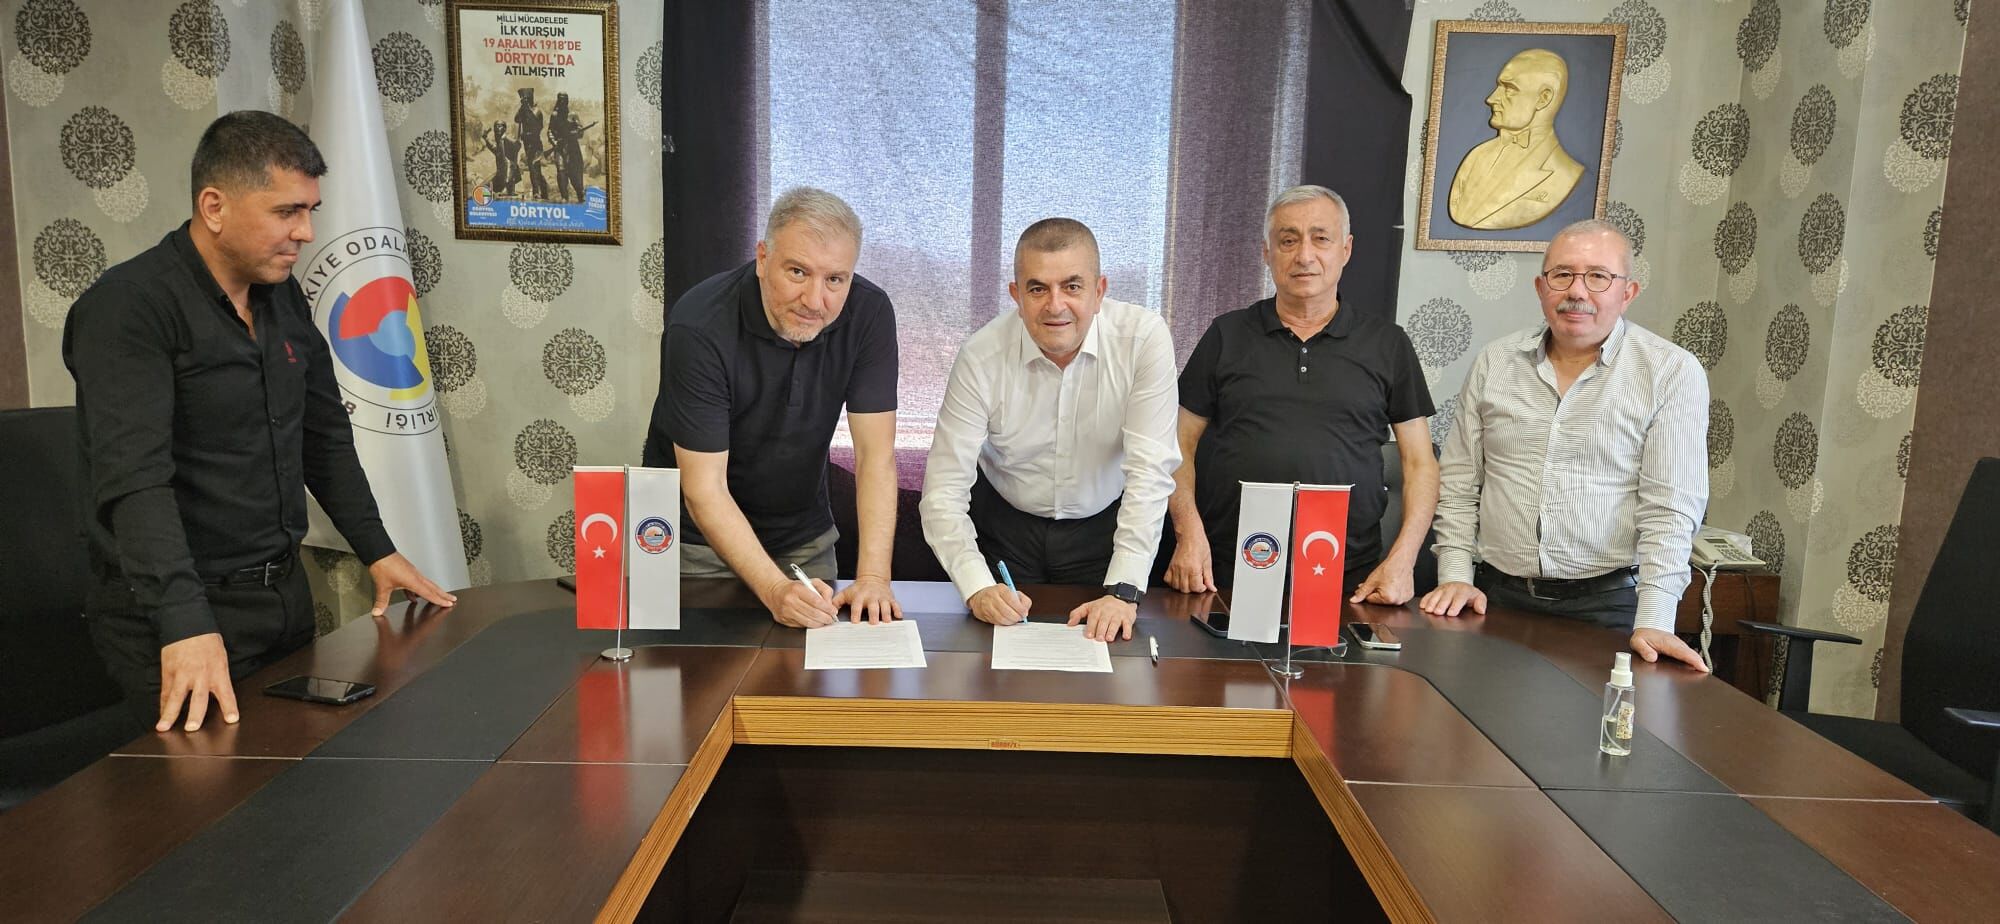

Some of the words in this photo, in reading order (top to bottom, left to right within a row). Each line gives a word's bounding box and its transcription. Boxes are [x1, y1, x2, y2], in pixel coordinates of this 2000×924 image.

[497, 13, 517, 23] MİLLİ
[518, 14, 568, 24] MÜCADELEDE
[500, 23, 518, 35] İLK
[521, 26, 565, 38] KURŞUN
[483, 38, 495, 48] 19
[497, 38, 537, 49] ARALIK
[540, 39, 581, 51] 1918'DE
[495, 49, 575, 65] DÖRTYOL'DA
[504, 65, 565, 78] ATILMIŞTIR
[510, 203, 570, 219] DÖRTYOL
[304, 252, 342, 302] KİYE
